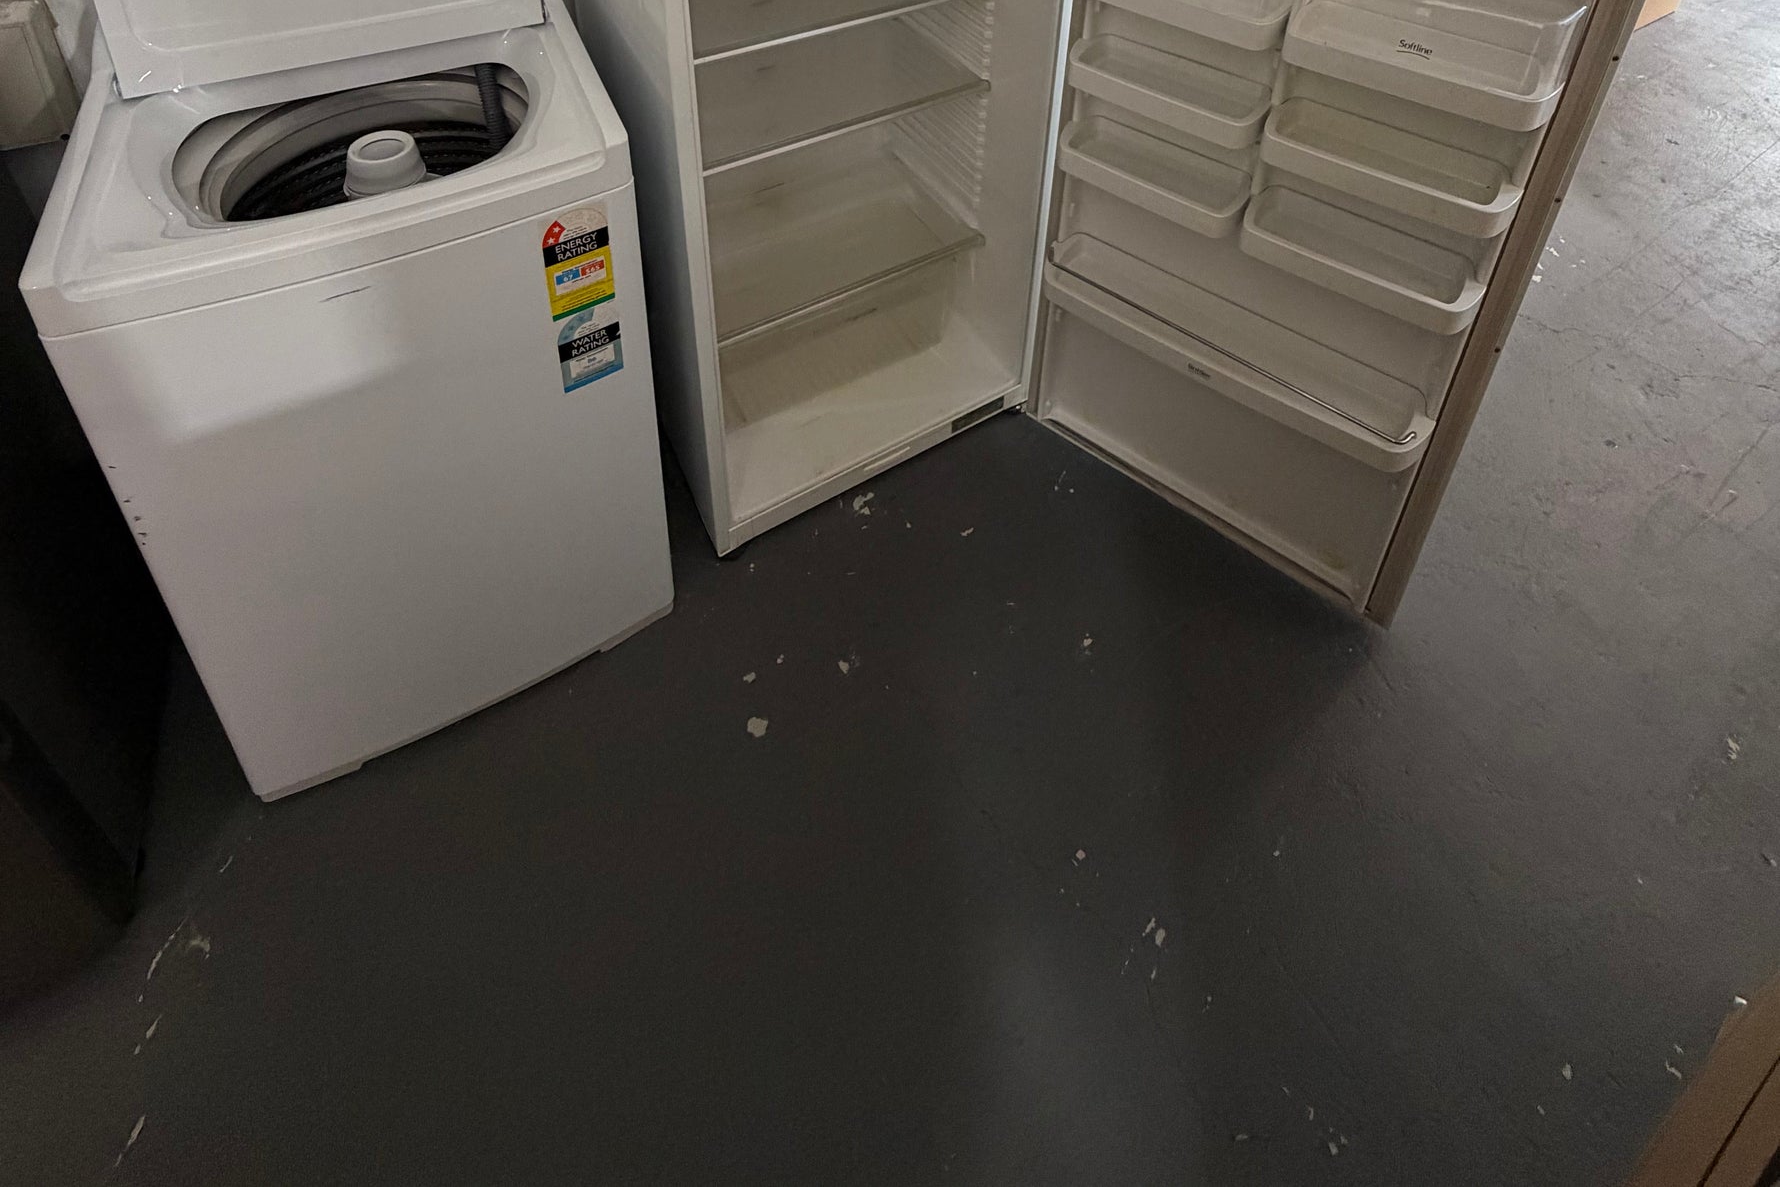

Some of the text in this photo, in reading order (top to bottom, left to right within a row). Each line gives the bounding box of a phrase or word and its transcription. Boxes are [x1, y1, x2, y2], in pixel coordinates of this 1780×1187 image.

[1398, 39, 1433, 55] Softline
[554, 232, 598, 254] ENERGY
[557, 241, 598, 261] RATING
[571, 329, 608, 348] WATER
[571, 335, 610, 357] RATING
